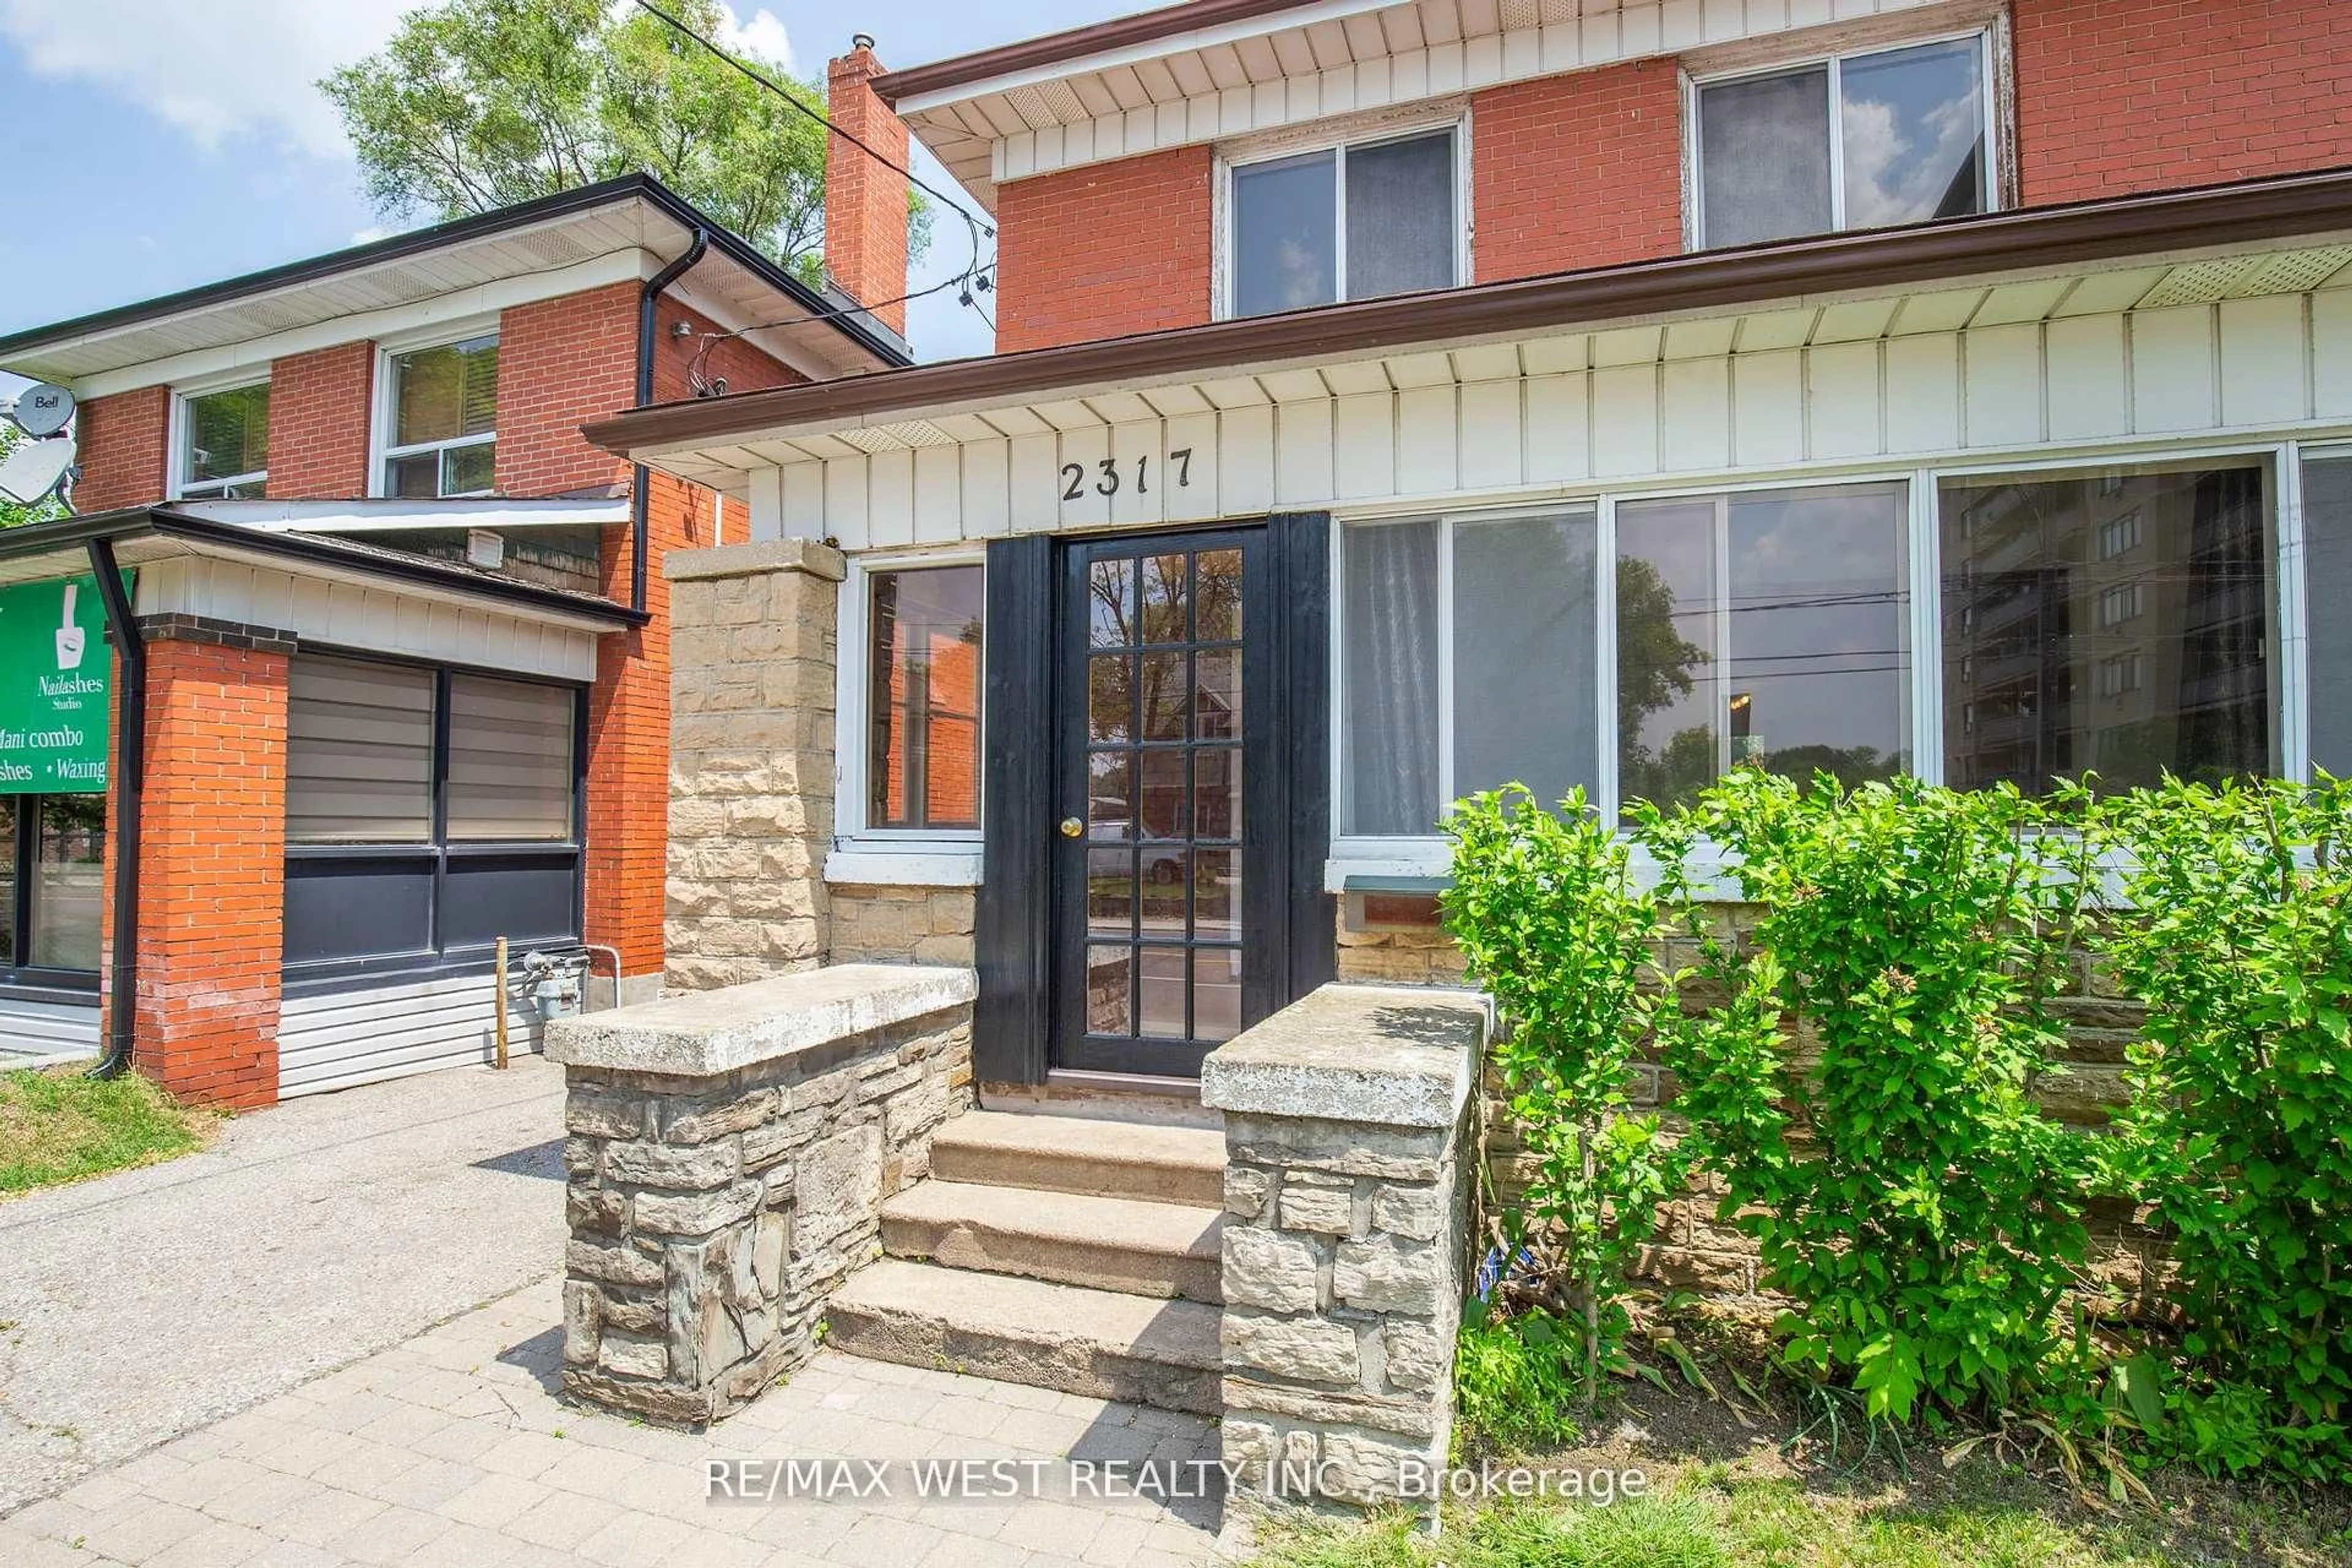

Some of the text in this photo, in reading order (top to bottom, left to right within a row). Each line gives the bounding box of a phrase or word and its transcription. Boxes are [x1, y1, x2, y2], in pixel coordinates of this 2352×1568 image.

[35, 396, 59, 409] Bell
[1061, 448, 1192, 500] 2317
[38, 672, 104, 696] Nailashes
[29, 724, 84, 748] combo
[56, 758, 106, 783] Waxing
